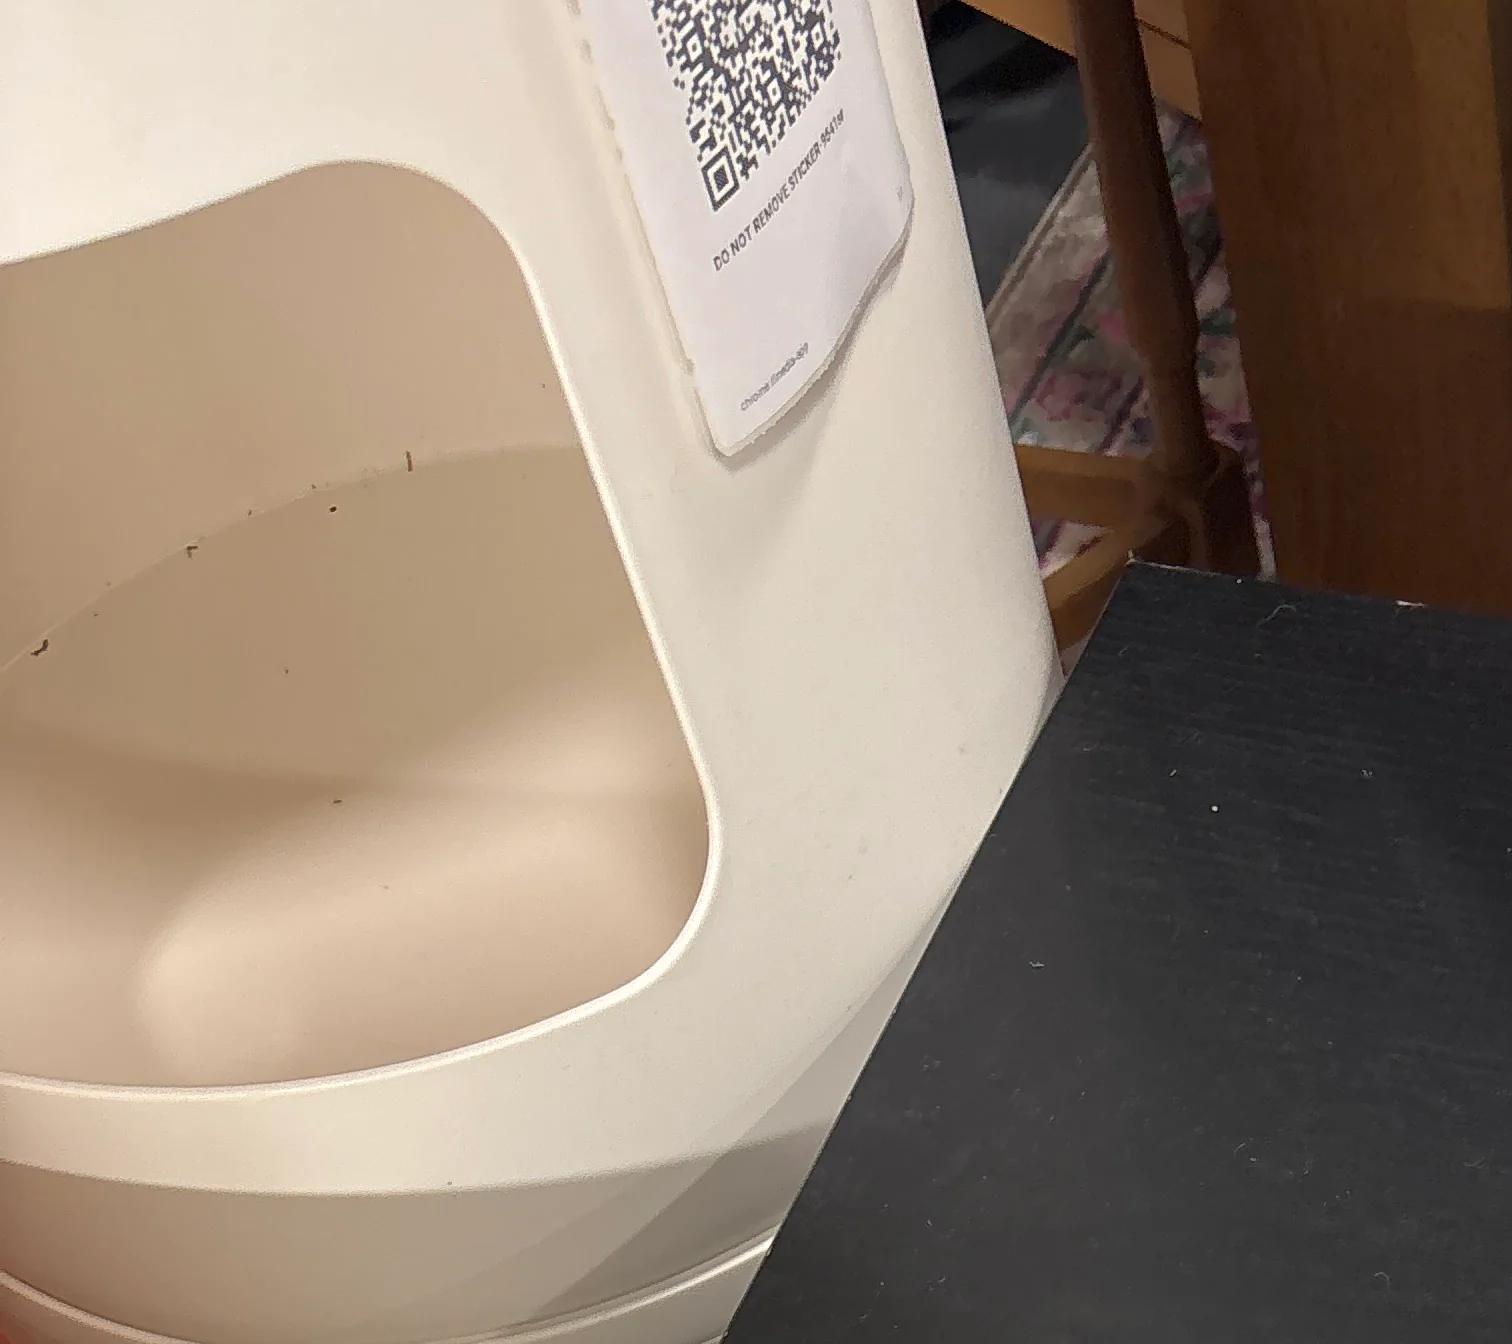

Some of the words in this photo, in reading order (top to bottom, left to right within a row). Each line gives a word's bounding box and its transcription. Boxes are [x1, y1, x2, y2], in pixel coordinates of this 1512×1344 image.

[712, 247, 731, 272] DO
[729, 225, 753, 257] NOT
[752, 183, 791, 234] REMOVE
